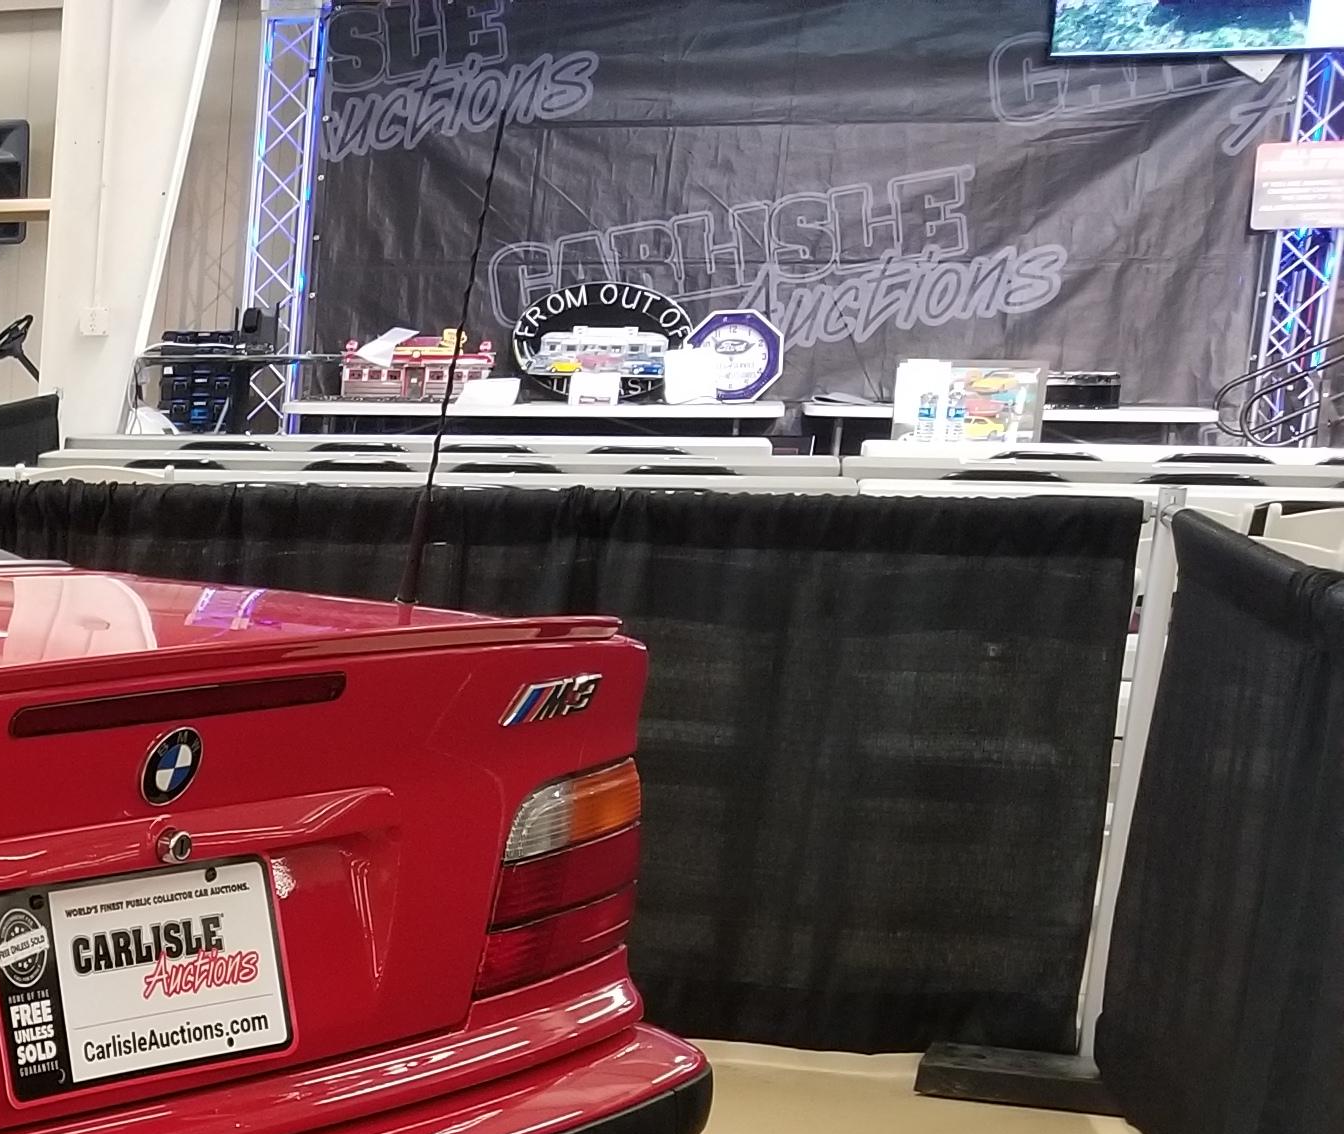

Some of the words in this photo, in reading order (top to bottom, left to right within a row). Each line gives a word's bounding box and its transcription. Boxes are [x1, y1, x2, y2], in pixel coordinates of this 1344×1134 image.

[489, 165, 969, 327] CARLISLE
[515, 285, 588, 337] FROM
[600, 284, 660, 313] OUT
[660, 308, 690, 340] OF
[65, 905, 98, 917] WORLD'S
[100, 901, 124, 913] FINEST
[126, 897, 151, 908] PUBLIC
[153, 891, 193, 904] COLLECTOR
[195, 888, 209, 898] CAR
[72, 915, 224, 976] CARLISLE
[143, 947, 259, 999] Auctions
[10, 999, 53, 1028] FREE
[14, 1024, 55, 1045] UNLESS
[16, 1040, 57, 1065] SOLD
[84, 1013, 268, 1062] CarlisleAuctions.com
[20, 1060, 59, 1078] GUARANTEE
